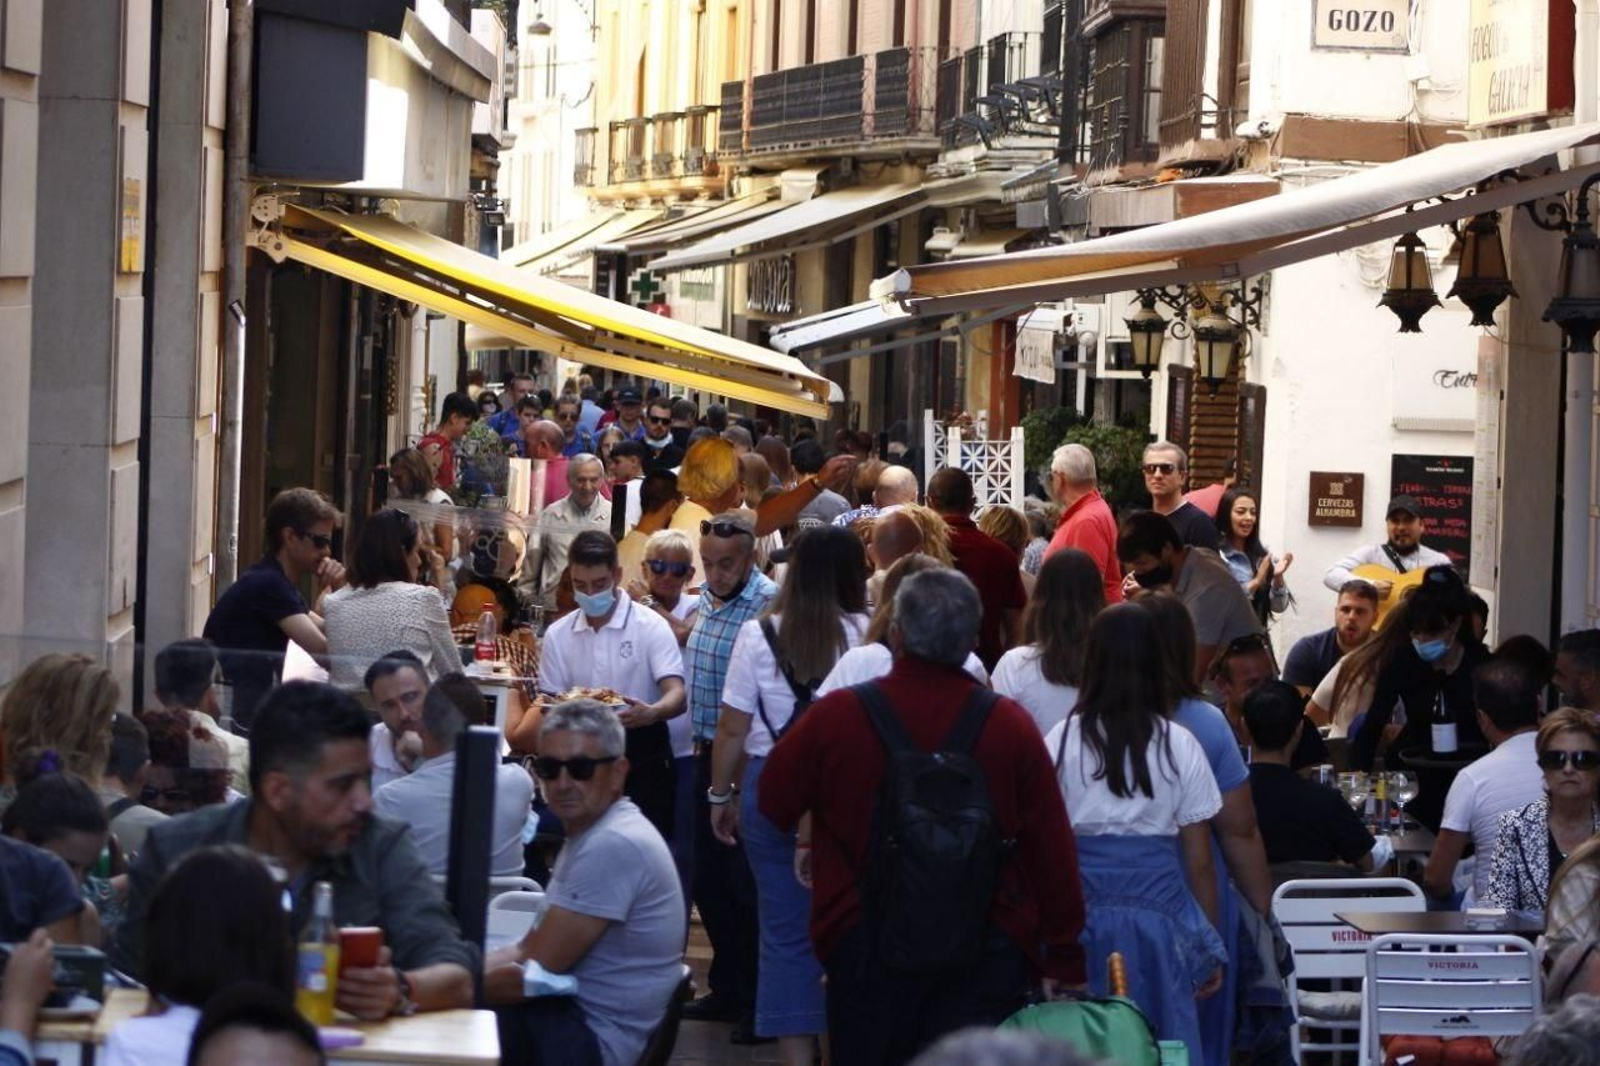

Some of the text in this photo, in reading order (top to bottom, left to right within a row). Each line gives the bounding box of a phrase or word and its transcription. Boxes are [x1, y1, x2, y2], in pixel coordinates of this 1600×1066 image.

[1328, 9, 1395, 33] GOZO
[1318, 497, 1355, 508] CERVEZAS
[1315, 507, 1356, 518] ALHAMBRA
[1331, 929, 1372, 942] VICTORIA
[1428, 961, 1479, 970] VICTORIA
